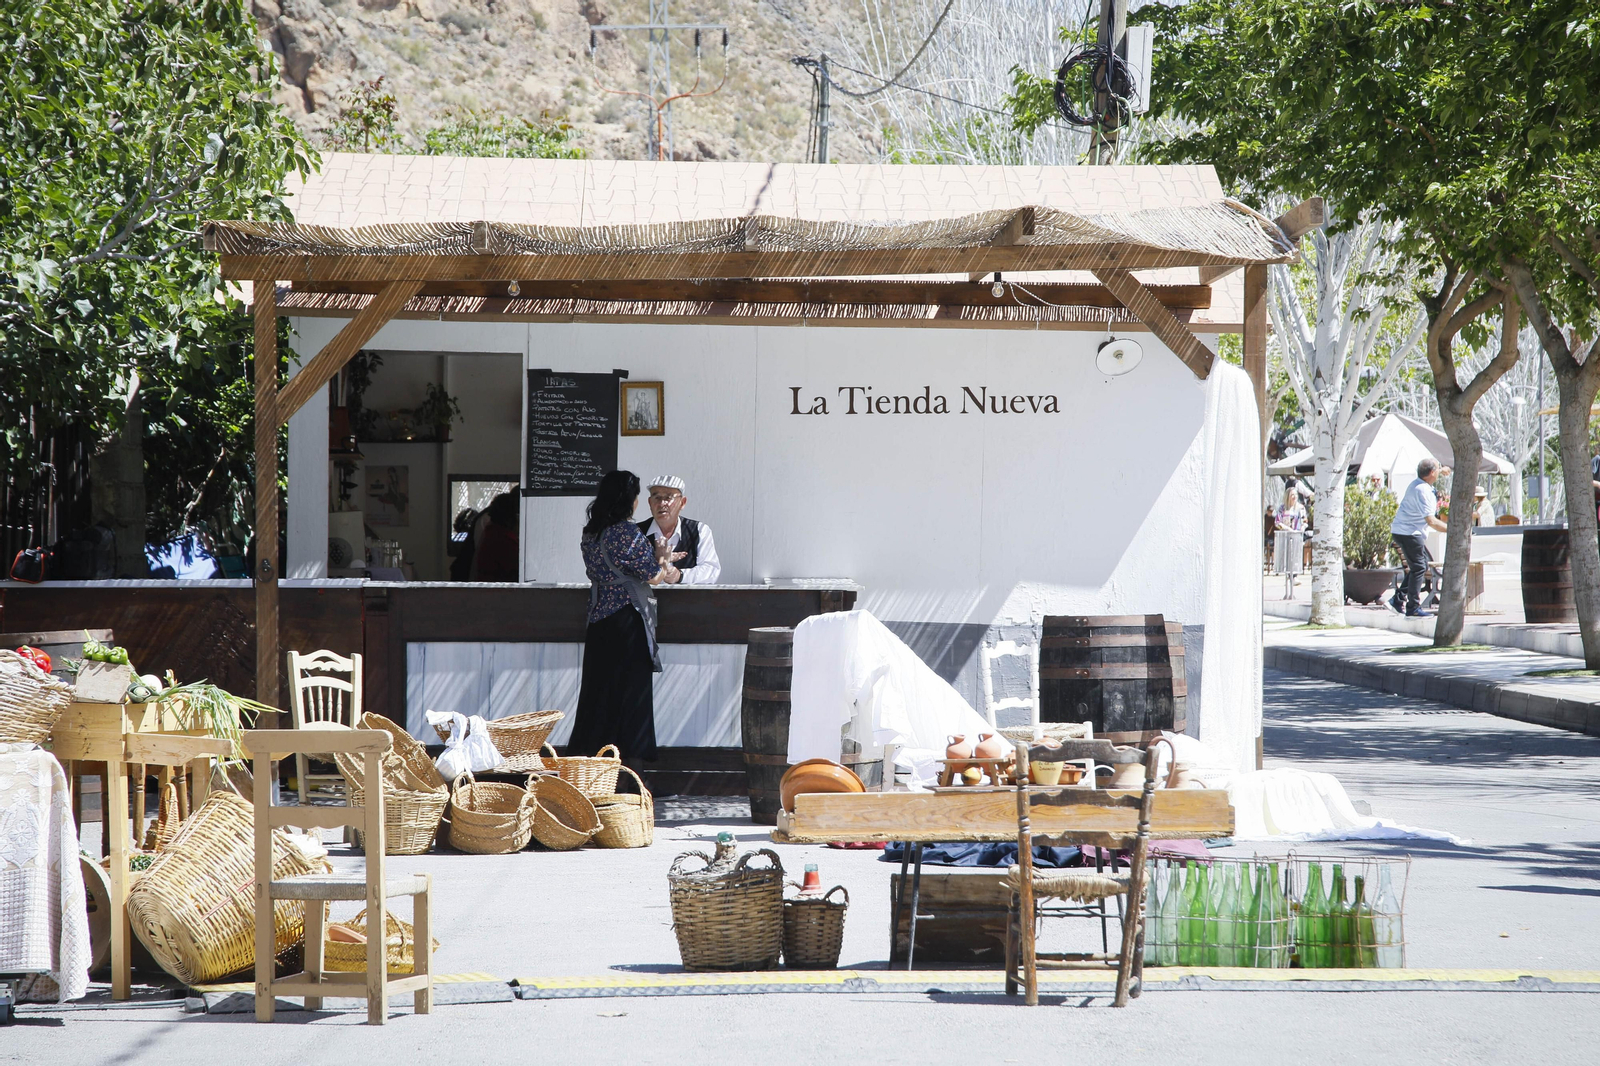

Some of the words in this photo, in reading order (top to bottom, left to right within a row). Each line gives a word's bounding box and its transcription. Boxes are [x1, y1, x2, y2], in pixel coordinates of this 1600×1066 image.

[789, 386, 830, 415] La
[838, 385, 950, 415] Tienda
[960, 386, 1061, 414] Nueva
